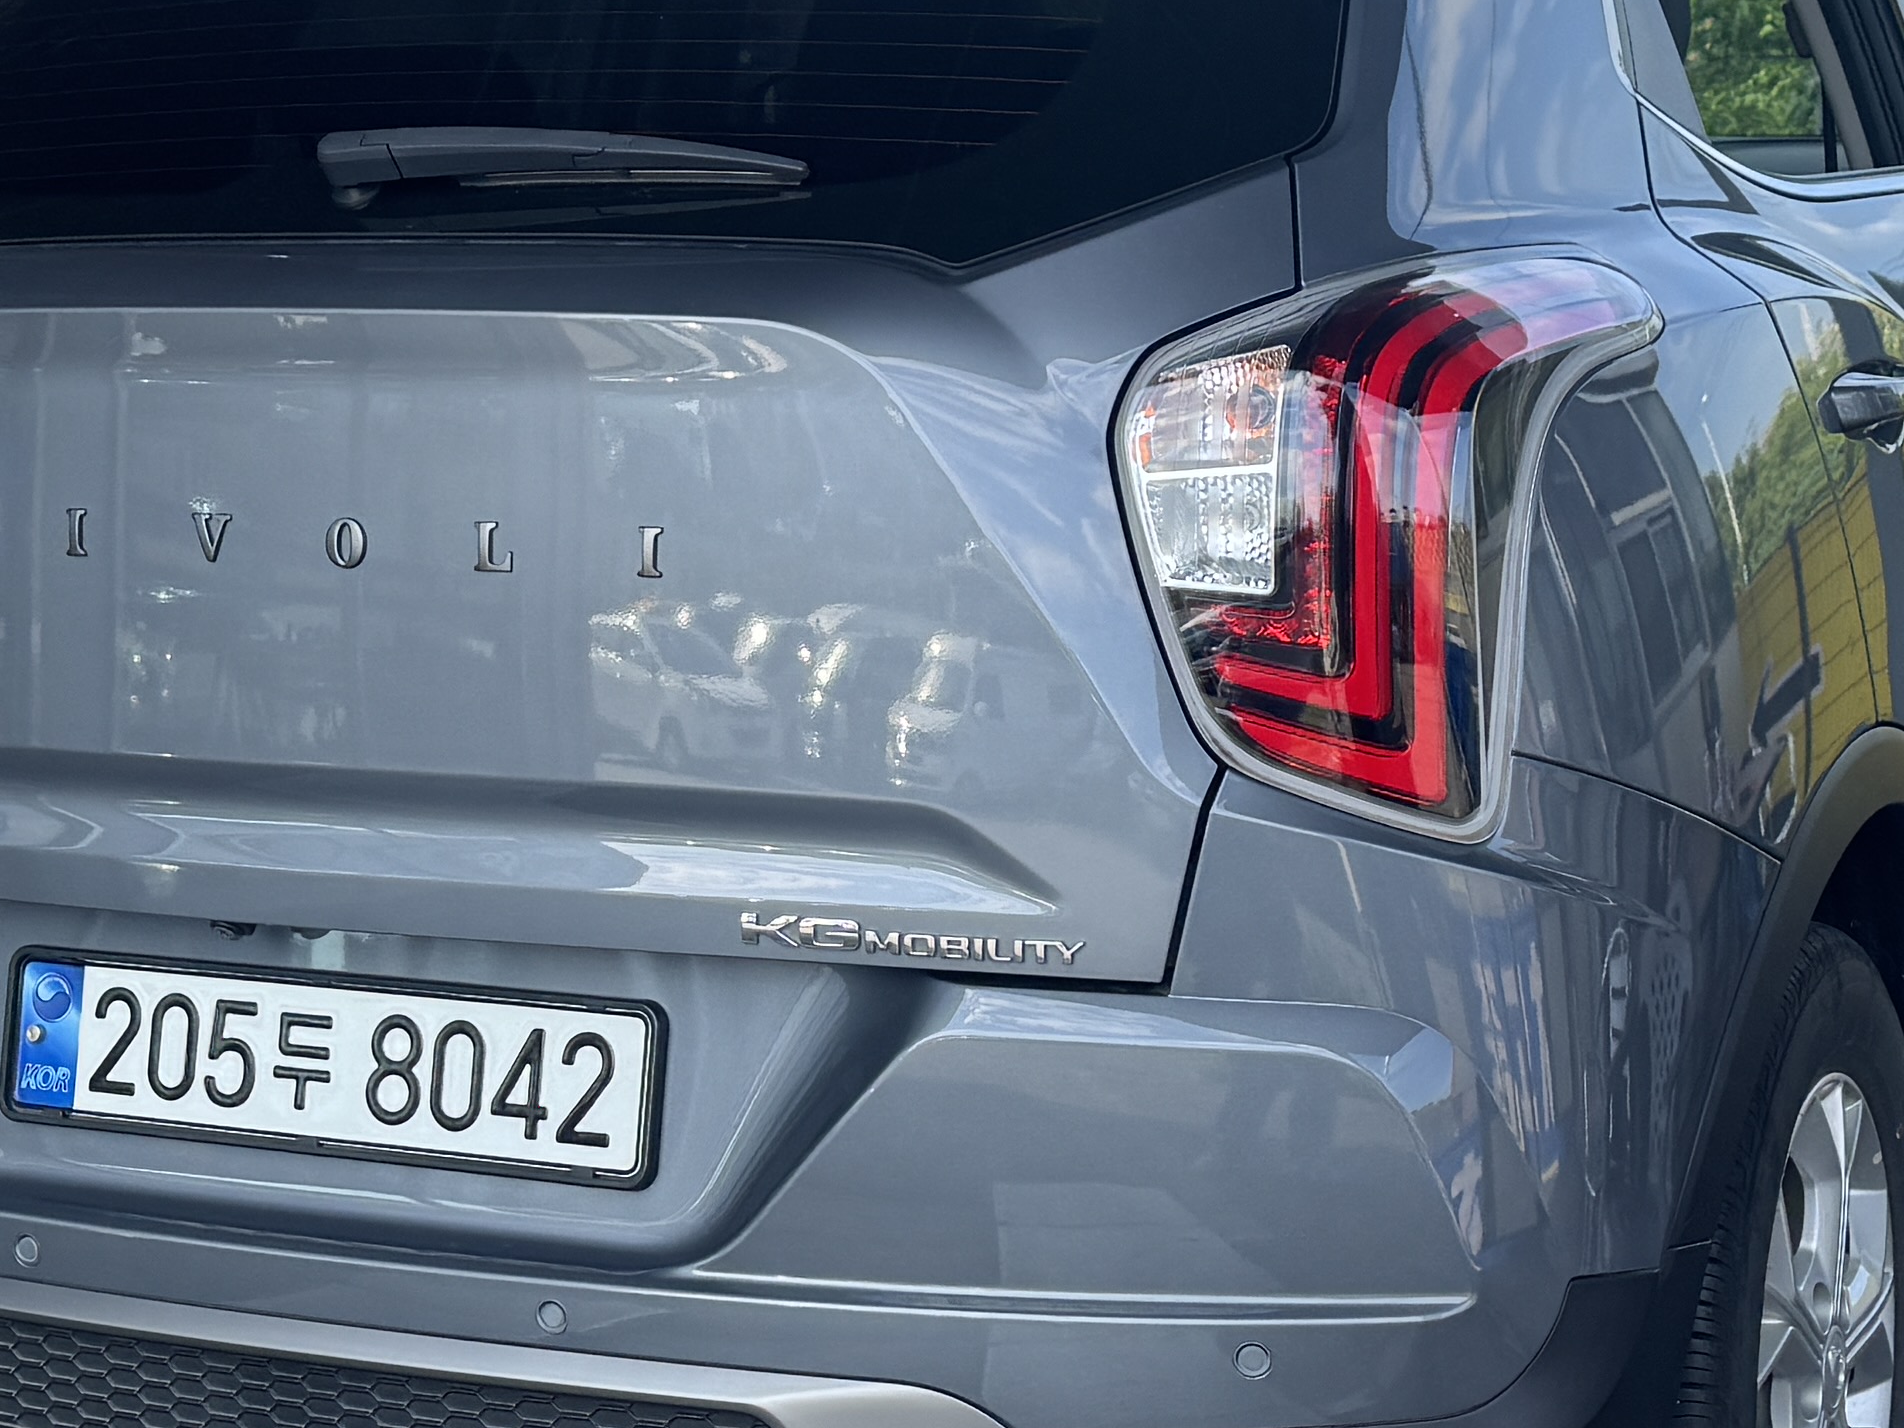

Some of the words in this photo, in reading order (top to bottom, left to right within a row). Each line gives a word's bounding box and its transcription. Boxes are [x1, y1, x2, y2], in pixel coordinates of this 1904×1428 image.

[739, 910, 863, 954] KG
[863, 931, 1088, 968] MOBILITY
[21, 1063, 70, 1095] KOR
[88, 985, 333, 1112] 205두
[365, 1013, 616, 1150] 8042
